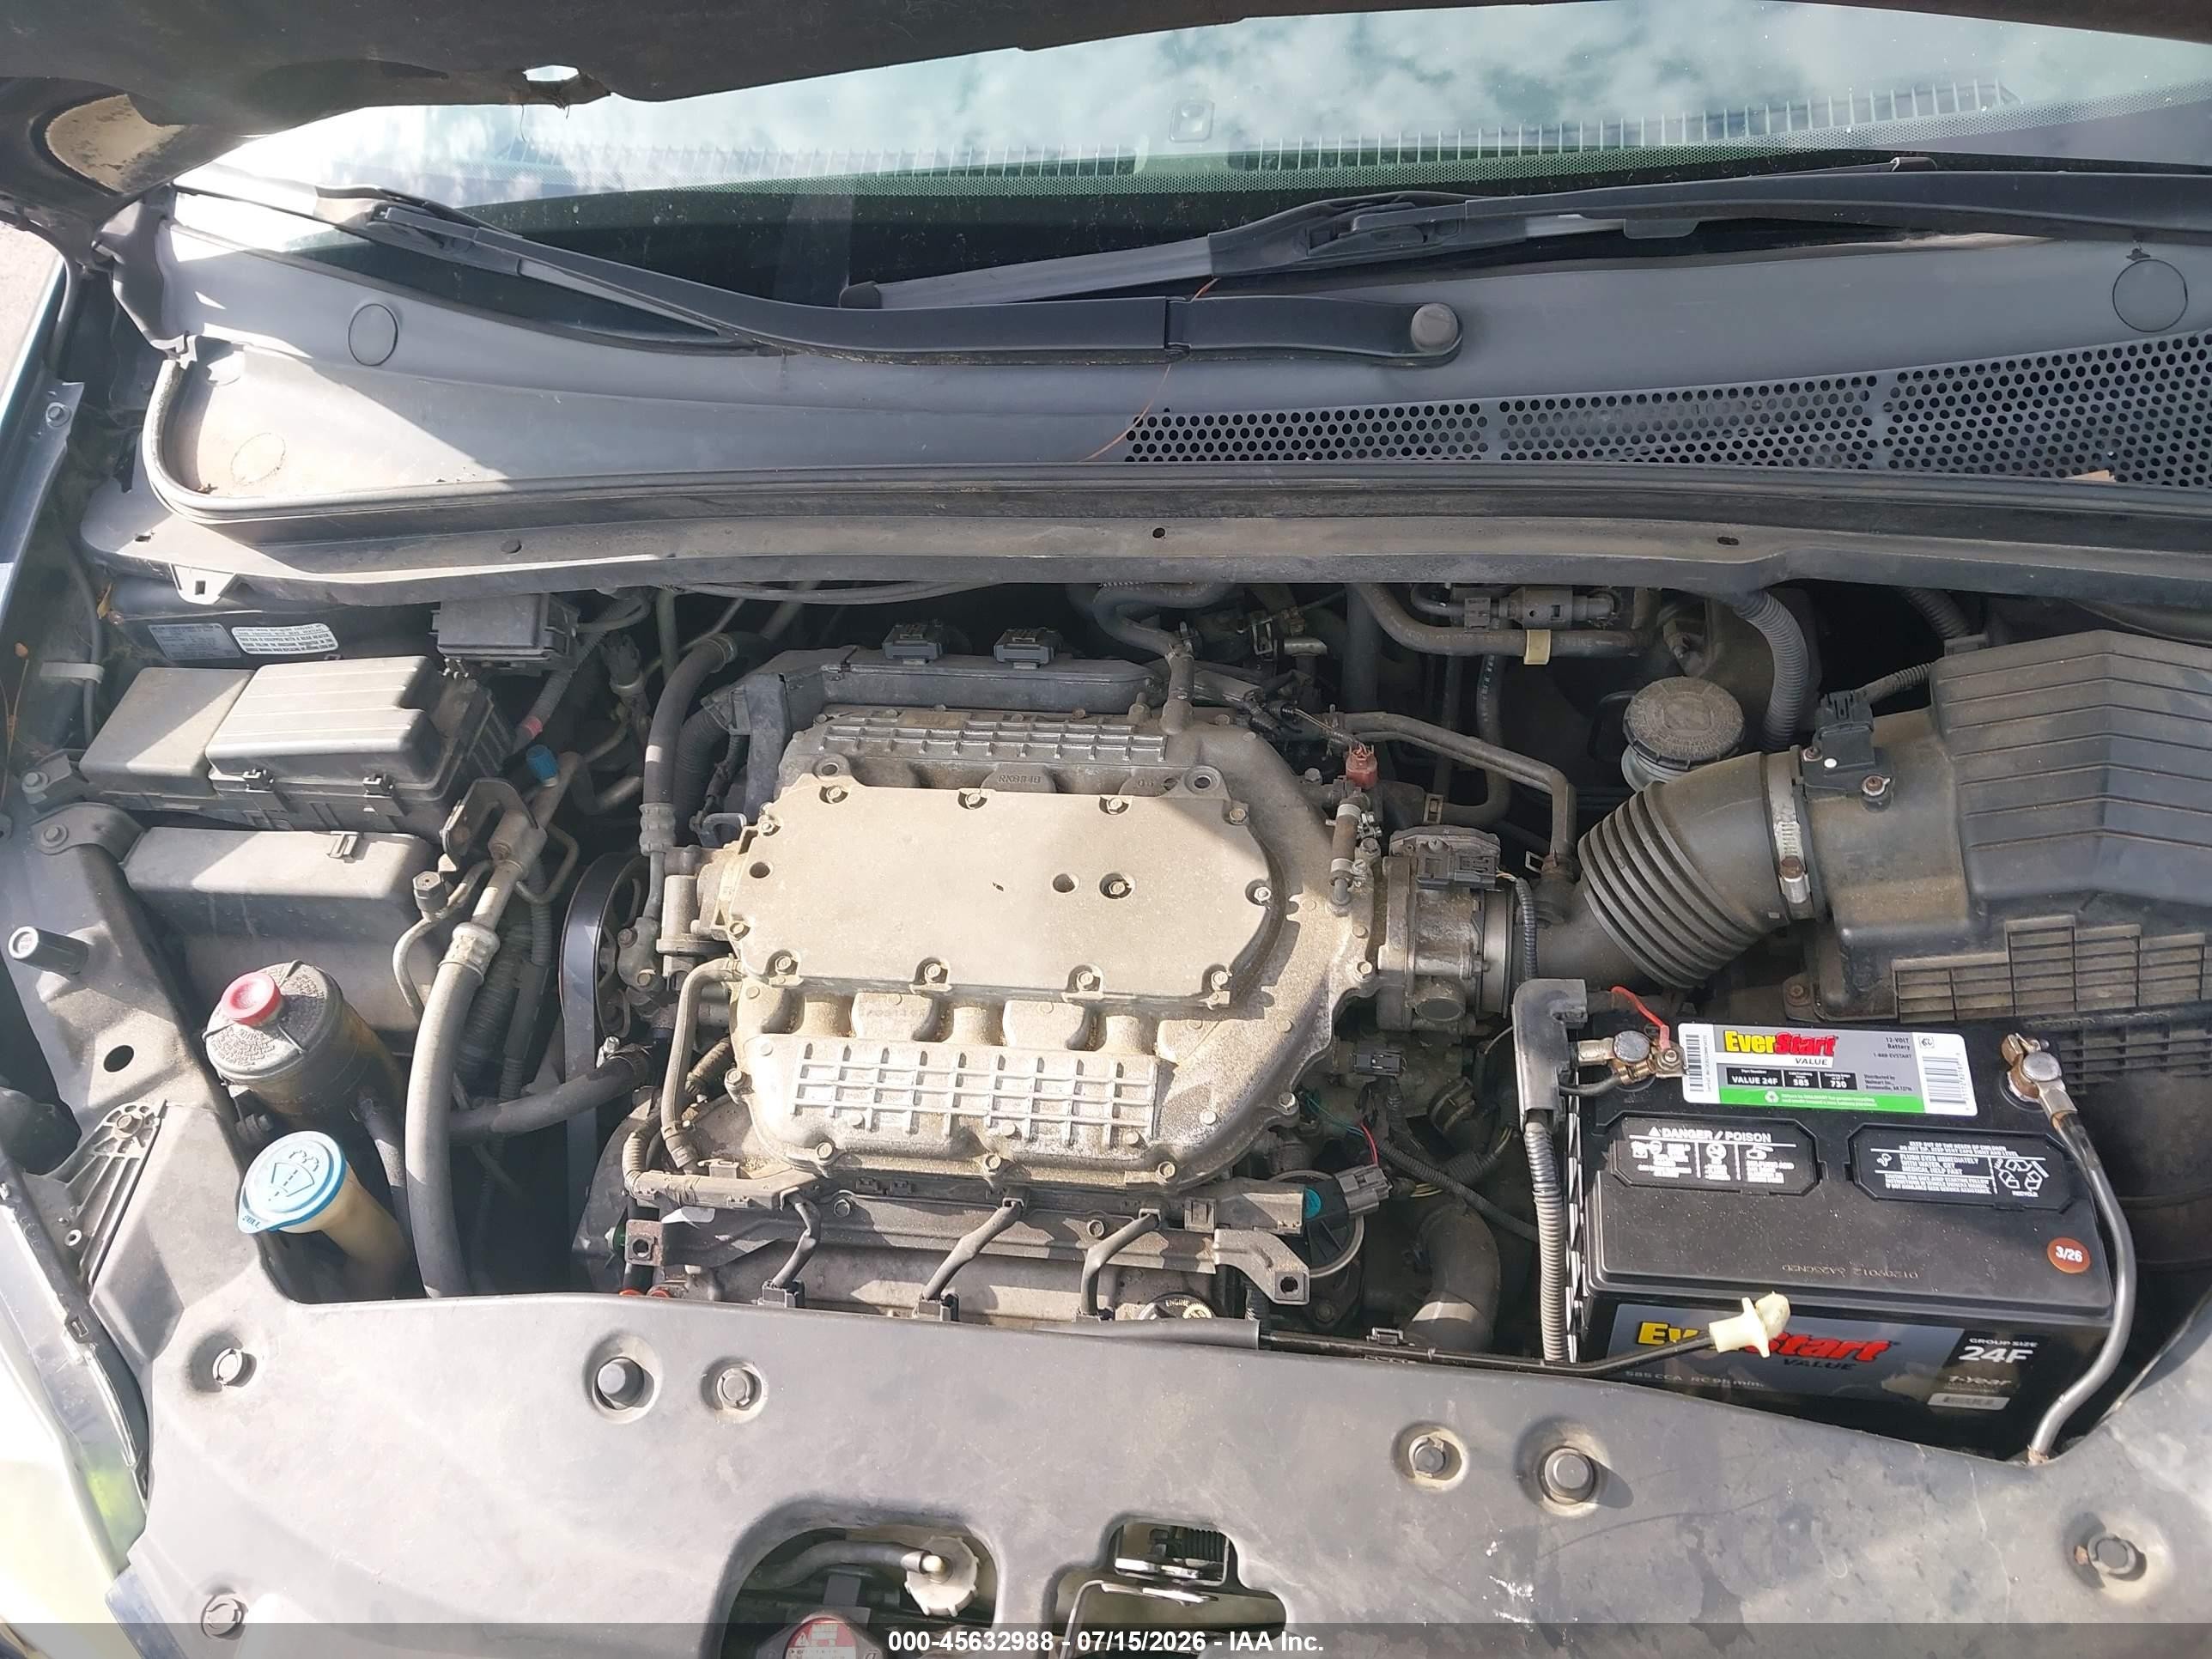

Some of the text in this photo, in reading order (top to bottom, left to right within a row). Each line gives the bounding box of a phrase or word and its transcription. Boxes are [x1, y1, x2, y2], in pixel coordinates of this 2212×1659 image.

[1723, 1030, 1837, 1057] EverStart
[1795, 1057, 1828, 1066] VALUE
[1731, 1075, 1778, 1085] VALUE 24F
[1662, 1127, 1771, 1143] DANGER / POISON
[2055, 1245, 2082, 1263] 3/26
[1969, 1338, 2010, 1346] GROUP
[1958, 1346, 2033, 1364] 24F
[1784, 1358, 1857, 1370] VALUE
